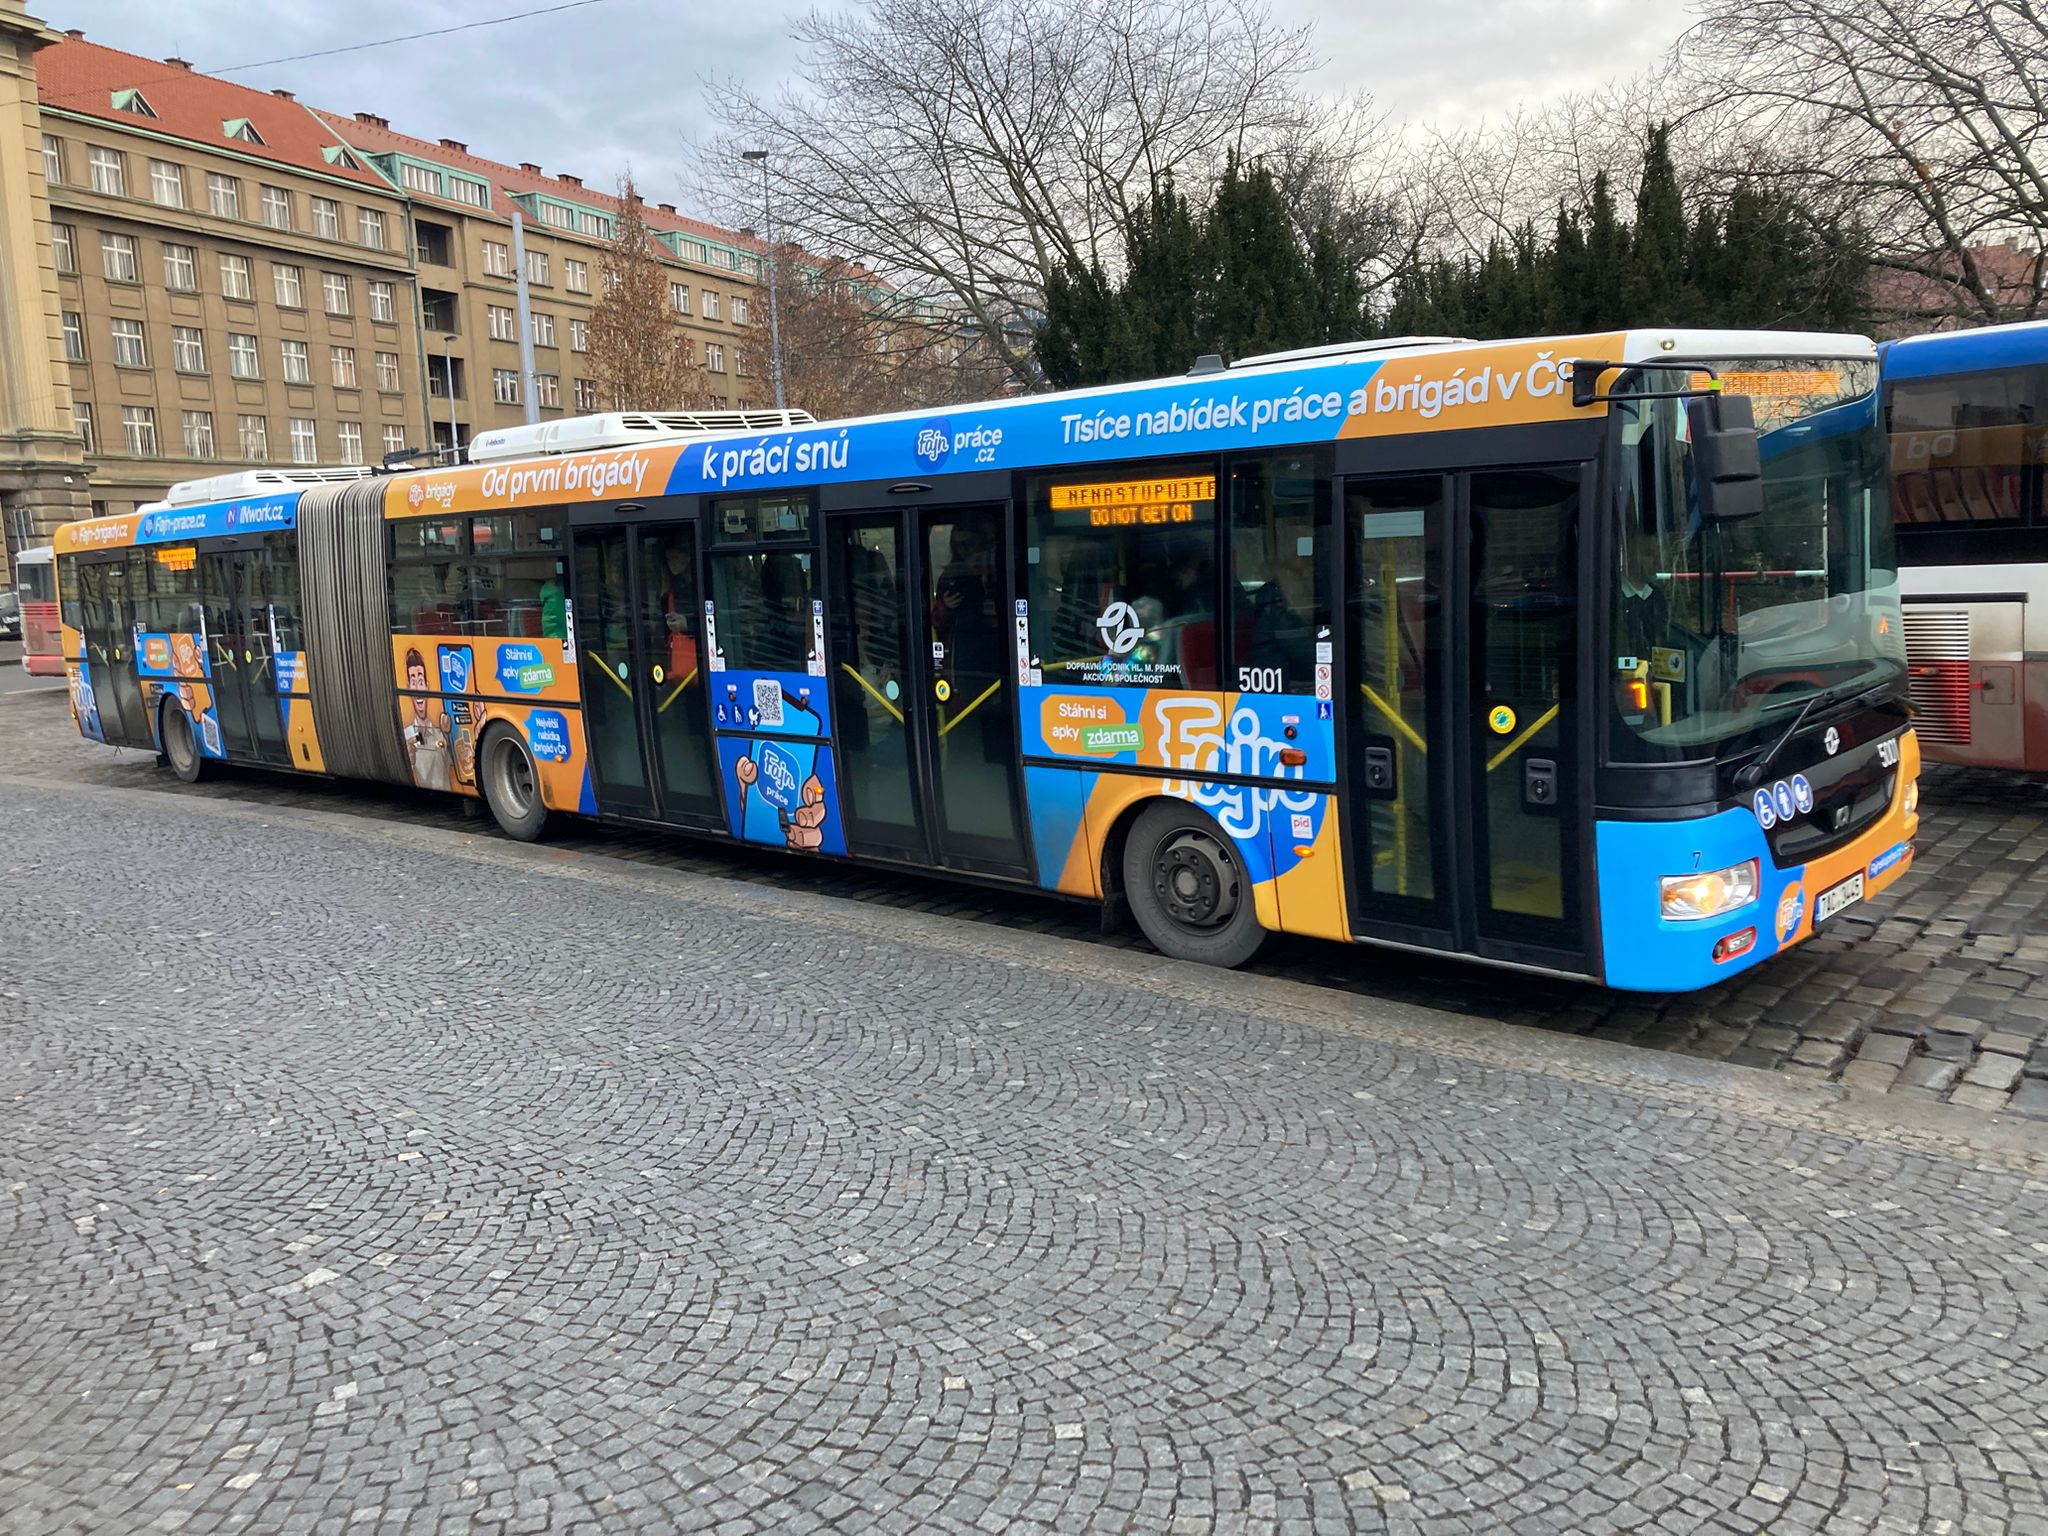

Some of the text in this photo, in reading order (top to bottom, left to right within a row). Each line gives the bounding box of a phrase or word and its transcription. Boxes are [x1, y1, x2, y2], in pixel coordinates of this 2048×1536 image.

[1060, 410, 1131, 444] Tisíce
[1136, 396, 1249, 436] nabídek
[1252, 386, 1342, 434] práce
[1347, 387, 1368, 416] a
[1375, 366, 1492, 419] brigád
[1496, 371, 1522, 400] v
[917, 425, 1003, 462] Fajn práce
[702, 429, 850, 488] k práci snů
[975, 447, 995, 463] .cz
[481, 451, 650, 502] Od první brigády
[426, 481, 457, 502] brigády
[1068, 480, 1216, 505] NENASTUPUJTE
[1090, 503, 1193, 527] DO NOT GET ON
[505, 648, 527, 661] Stáhni
[502, 667, 552, 682] apky zdarma
[1066, 661, 1100, 671] DOPRAVNÍ
[1102, 662, 1130, 672] PODNIK
[1131, 663, 1144, 672] HL.
[1145, 664, 1154, 672] M.
[1082, 672, 1164, 684] AKCIOVÁ SPOLEČNOST
[1238, 667, 1283, 693] 5001
[1058, 702, 1107, 719] Stáhni si
[1052, 725, 1140, 746] apky zdarma
[763, 748, 796, 791] Fajn
[766, 785, 789, 806] práce
[1293, 816, 1310, 829] pid
[1692, 851, 1702, 868] 7
